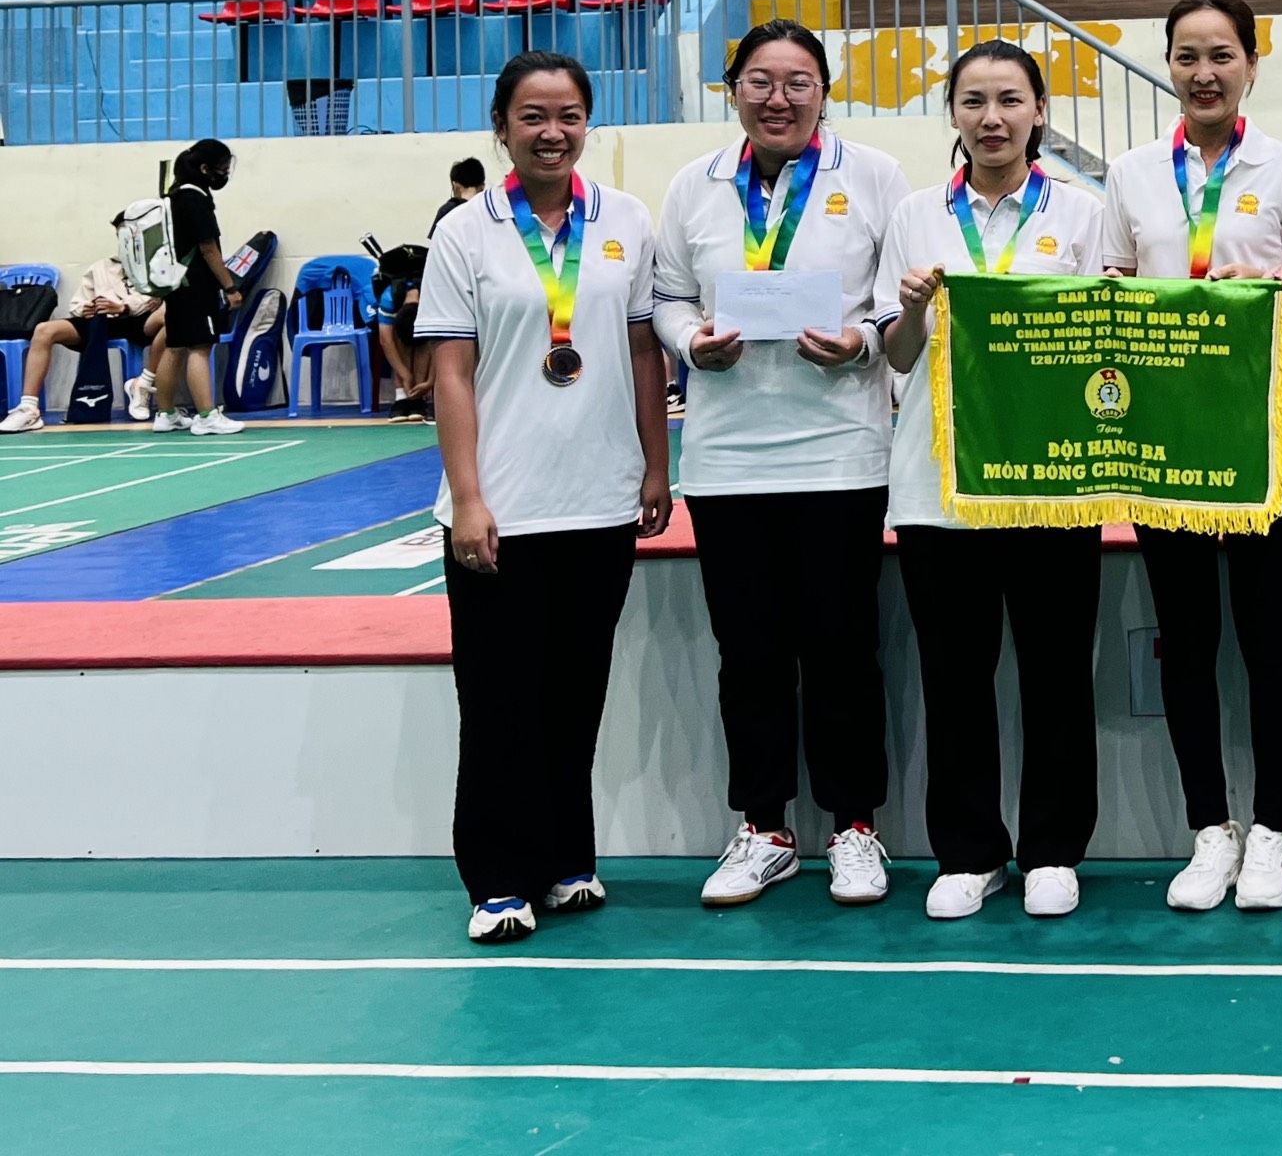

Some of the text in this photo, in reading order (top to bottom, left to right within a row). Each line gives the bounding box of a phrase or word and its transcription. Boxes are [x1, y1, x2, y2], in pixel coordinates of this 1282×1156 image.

[1057, 285, 1156, 304] BAN TỔ CHỨC
[990, 309, 1227, 328] HỘI THAO CỤM THI ĐUA SỐ 4
[1016, 328, 1050, 339] CHÀO
[1115, 327, 1144, 340] NIỆM
[1148, 329, 1166, 340] 95
[989, 338, 1230, 357] NGÀY THÀNH LẬP CÔNG ĐOÀN VIỆT NAM
[1048, 439, 1167, 461] ĐỘI HẠNG BA
[983, 460, 1028, 480] MÔN
[1033, 461, 1086, 481] BÓNG
[1165, 468, 1203, 486] HƠI
[1208, 468, 1238, 487] NỮ
